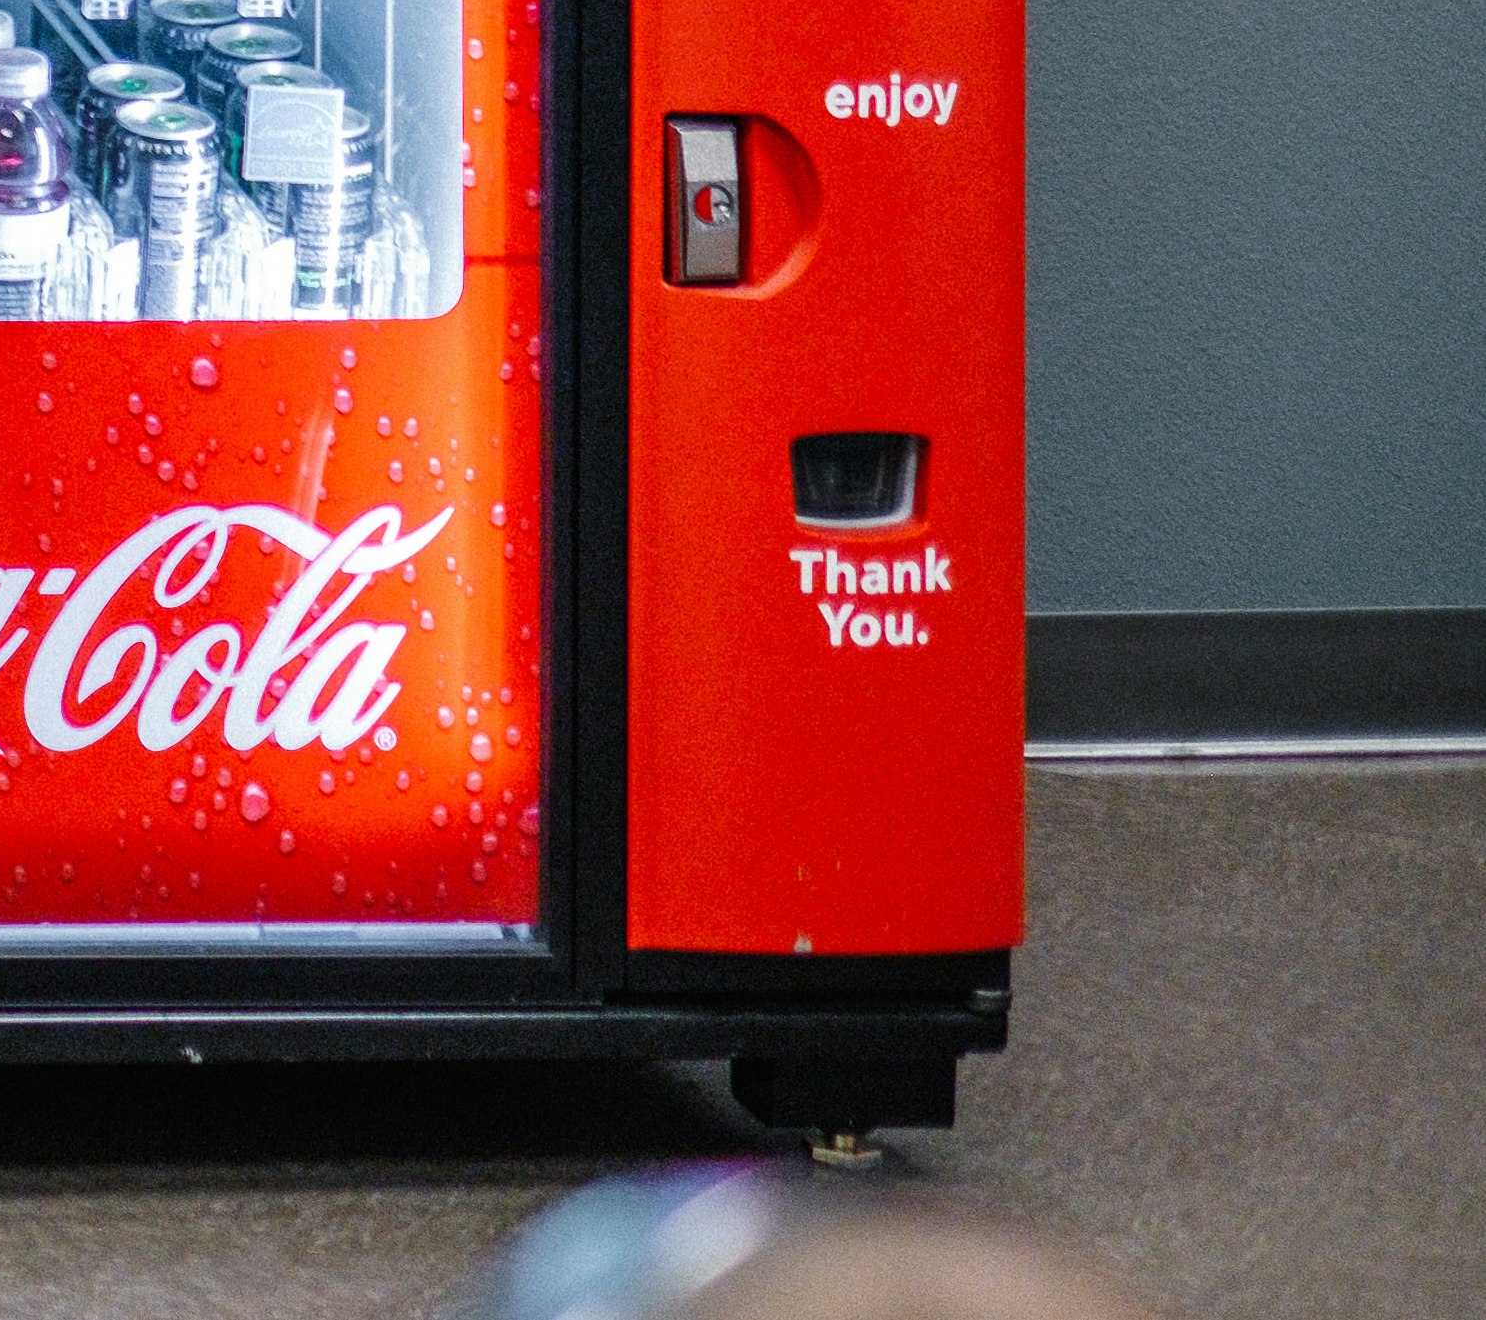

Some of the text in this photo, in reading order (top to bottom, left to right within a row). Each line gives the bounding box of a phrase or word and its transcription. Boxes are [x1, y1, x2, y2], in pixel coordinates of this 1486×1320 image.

[824, 73, 959, 126] enjoy
[788, 547, 952, 595] Thank
[817, 602, 930, 647] You.
